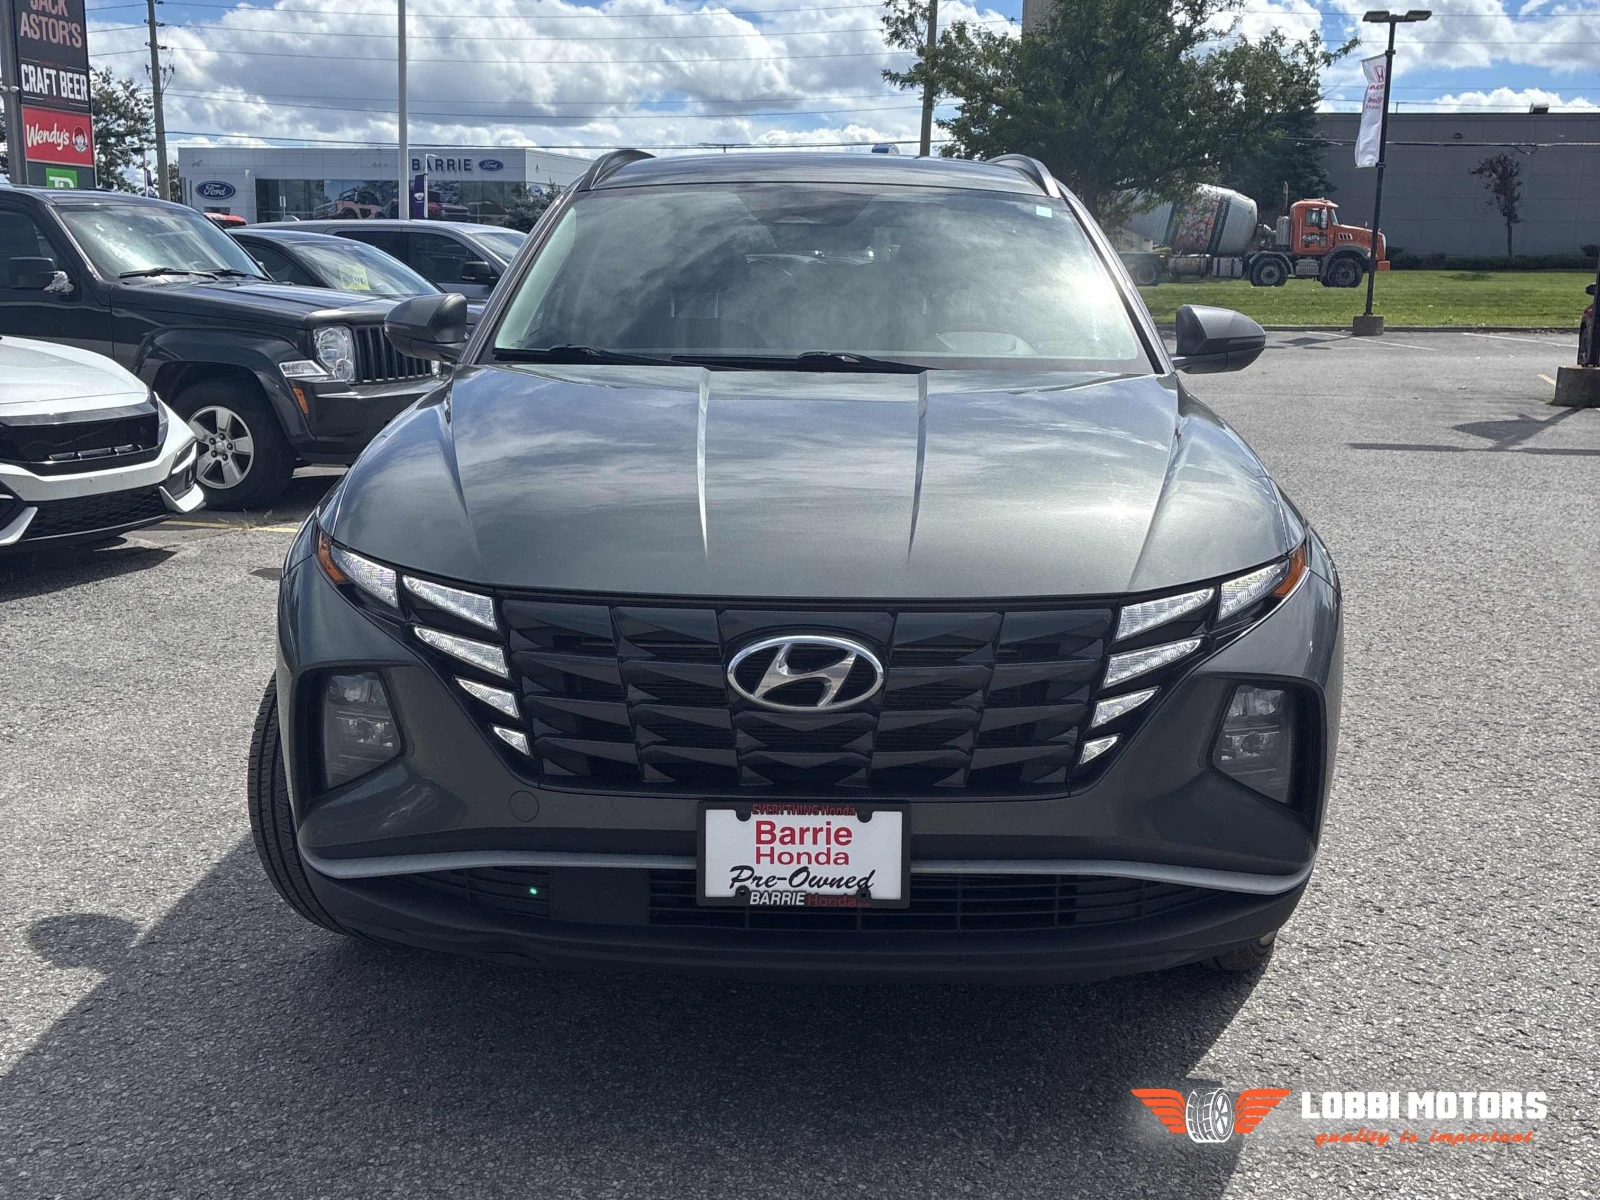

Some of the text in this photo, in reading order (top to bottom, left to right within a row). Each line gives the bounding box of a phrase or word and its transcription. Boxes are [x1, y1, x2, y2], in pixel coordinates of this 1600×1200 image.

[20, 11, 82, 49] ASTOR'S
[21, 63, 88, 102] CRAFT BEER
[26, 123, 70, 151] Wendy's
[411, 158, 473, 171] BARRIE
[751, 803, 856, 817] EVERYTHING Honda
[755, 820, 853, 846] Barrie
[755, 846, 850, 866] Honda
[729, 865, 876, 890] Pre-Owned
